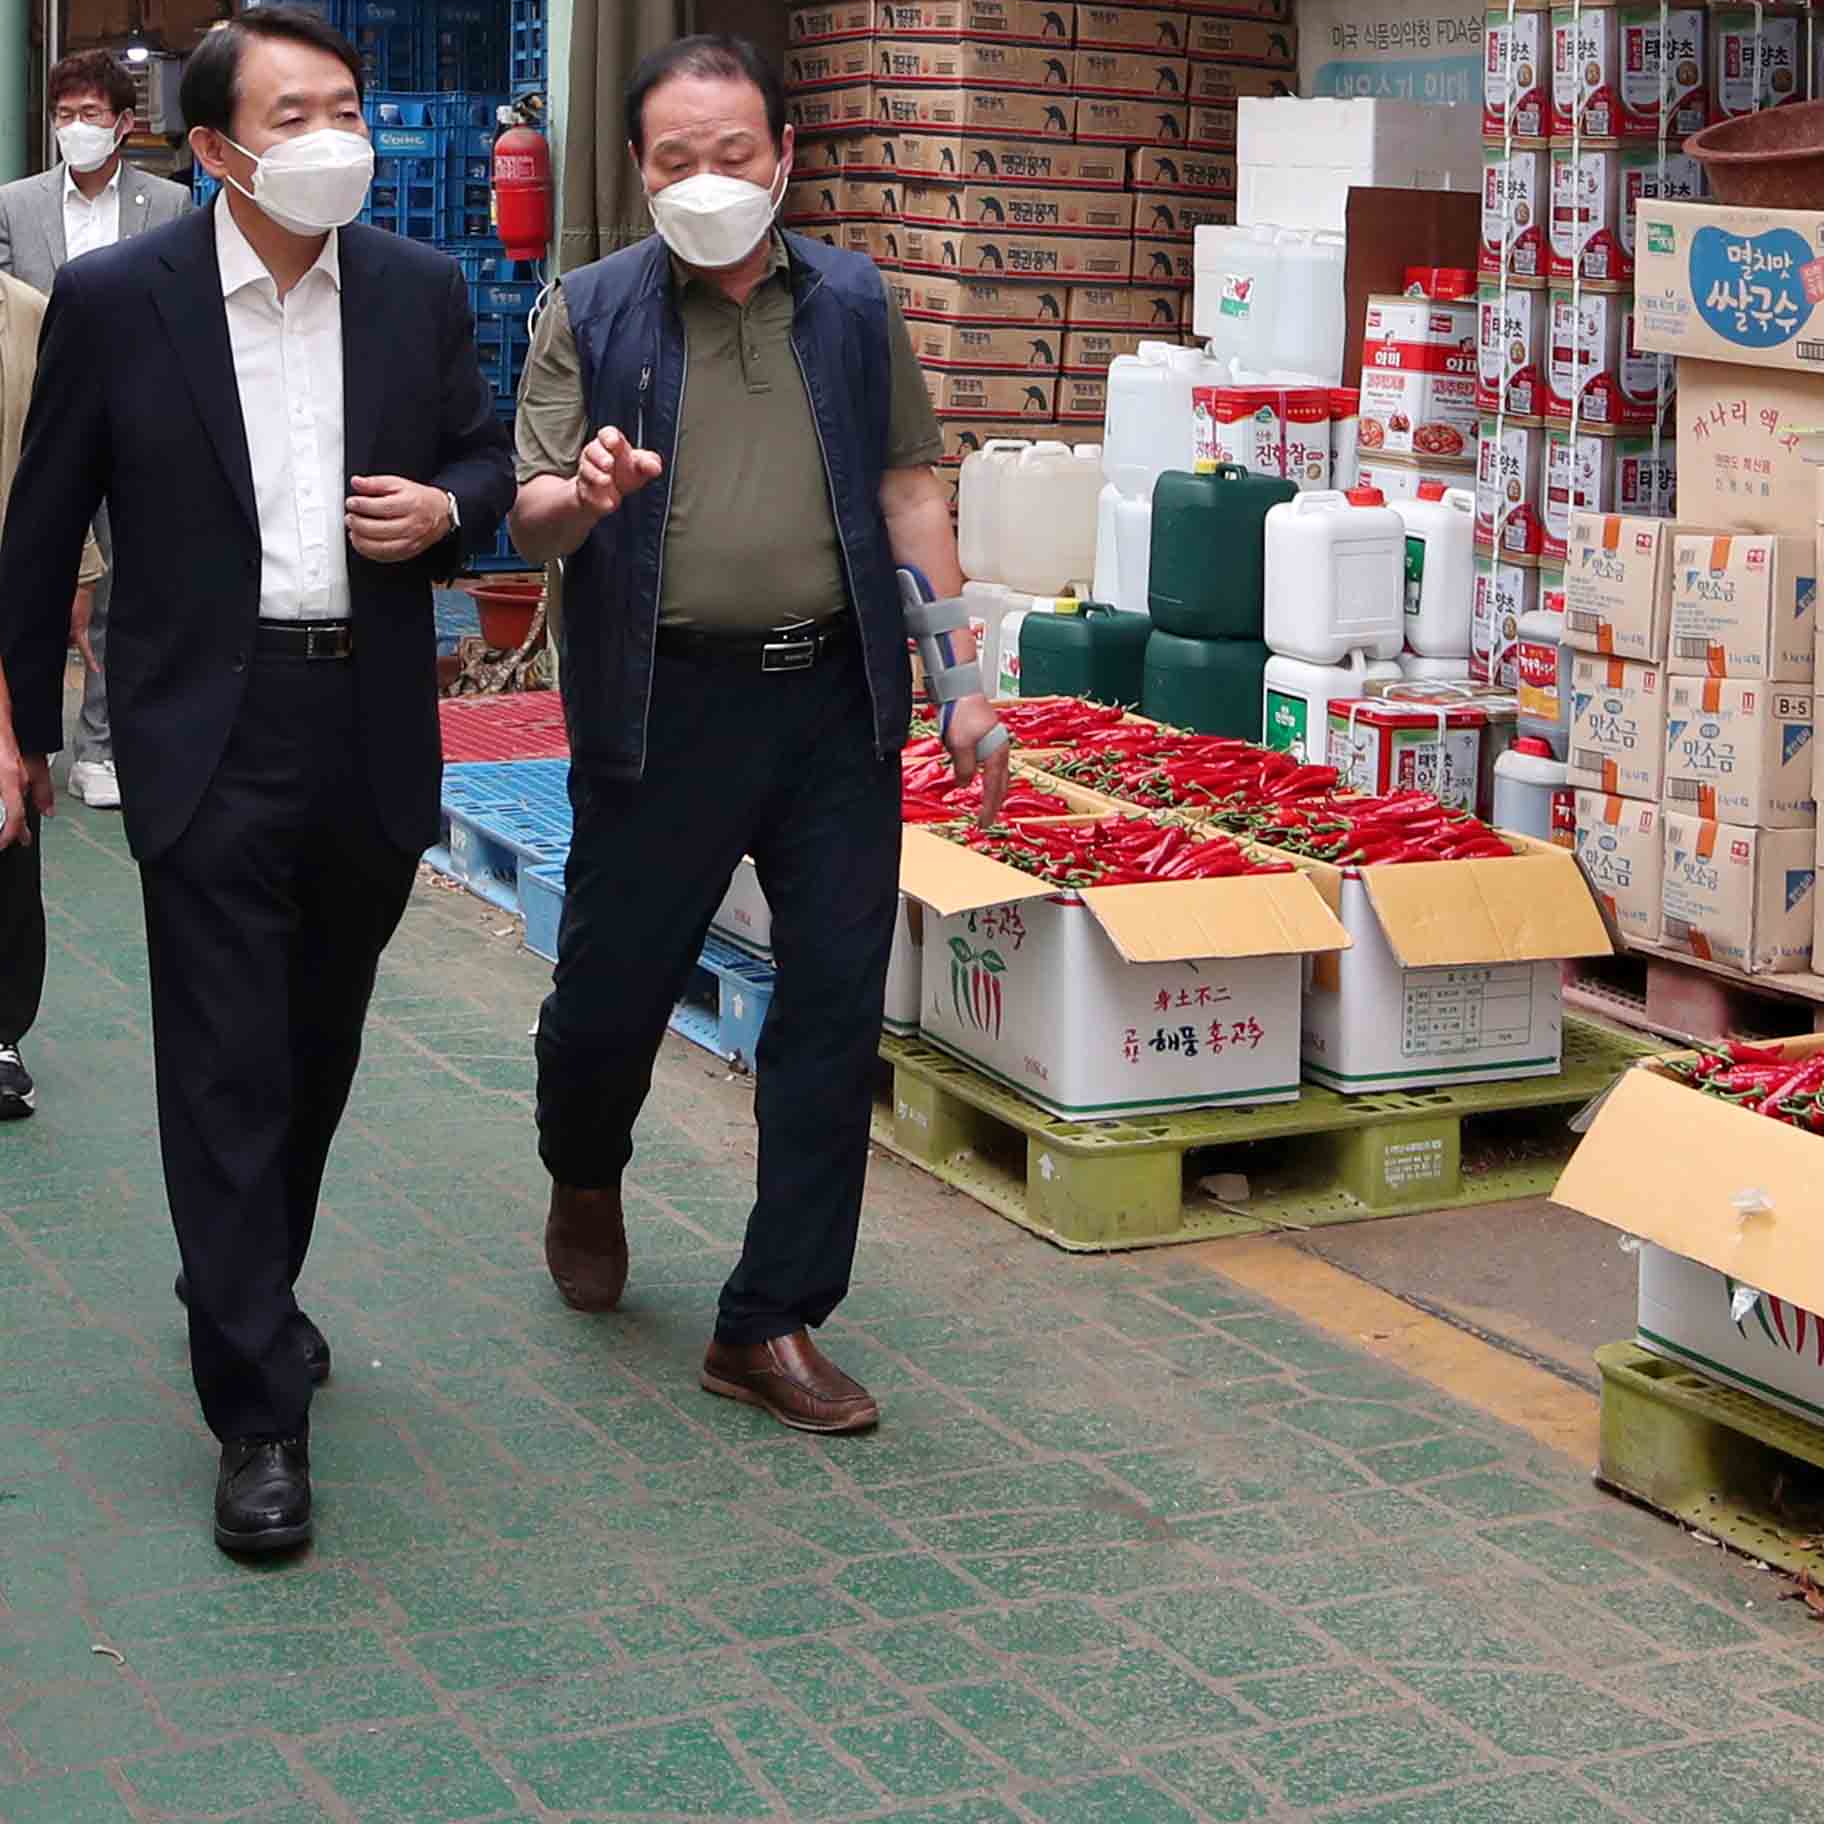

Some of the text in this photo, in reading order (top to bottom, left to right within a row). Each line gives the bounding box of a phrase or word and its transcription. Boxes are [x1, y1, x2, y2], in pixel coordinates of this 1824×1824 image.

[1437, 15, 1485, 44] FDA승
[1727, 240, 1793, 280] 멸치맛
[1706, 279, 1799, 334] 쌀국수
[1639, 466, 1676, 492] 태양
[1592, 557, 1625, 583] 맛소금
[1697, 579, 1736, 601] 맛소금
[1779, 705, 1808, 716] B-5
[1589, 713, 1638, 749] 맛소금
[1683, 743, 1736, 773] 맛소금
[1586, 850, 1632, 887] 맛소금
[1683, 862, 1719, 890] 맛소금
[1148, 1019, 1266, 1058] 해풍 홍고추
